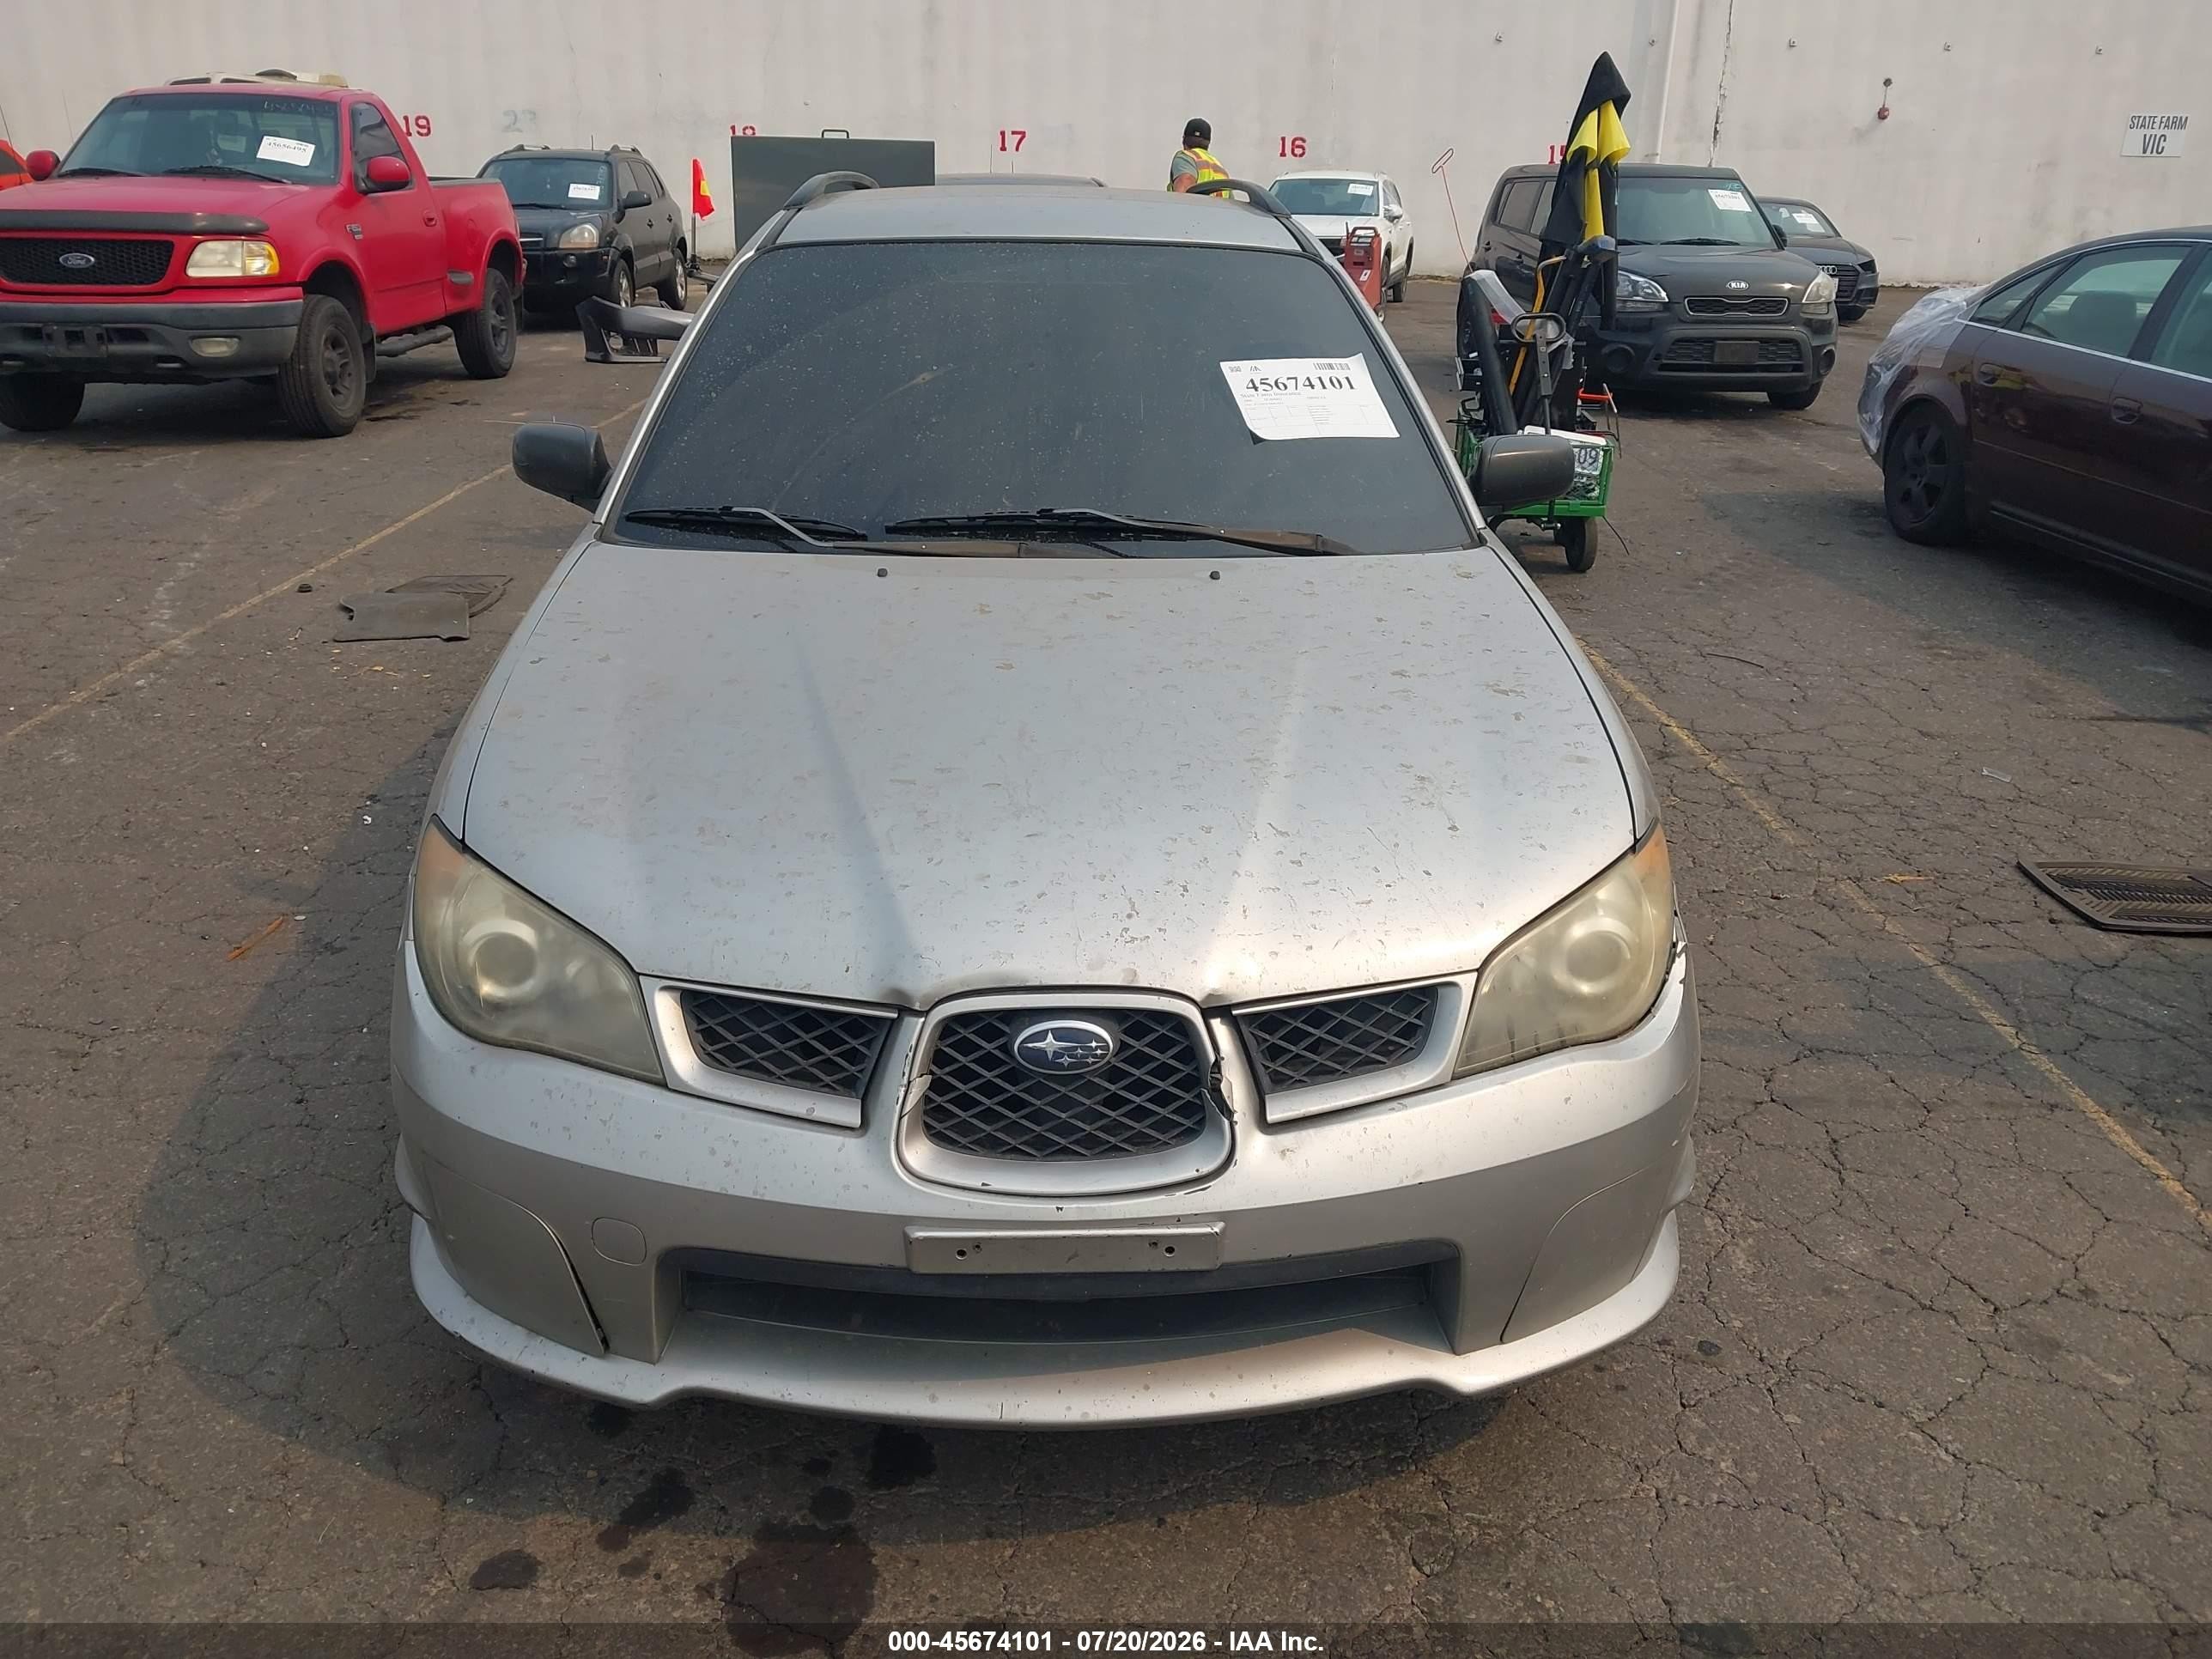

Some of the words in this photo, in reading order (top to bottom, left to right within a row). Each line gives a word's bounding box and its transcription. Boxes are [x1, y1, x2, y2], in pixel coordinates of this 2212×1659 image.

[403, 115, 431, 137] 19
[2130, 115, 2158, 130] STATE
[2158, 115, 2188, 130] FARM
[1000, 130, 1026, 152] 17
[1279, 137, 1306, 158] 16
[2142, 133, 2166, 155] VIC
[1246, 376, 1357, 392] 45674101
